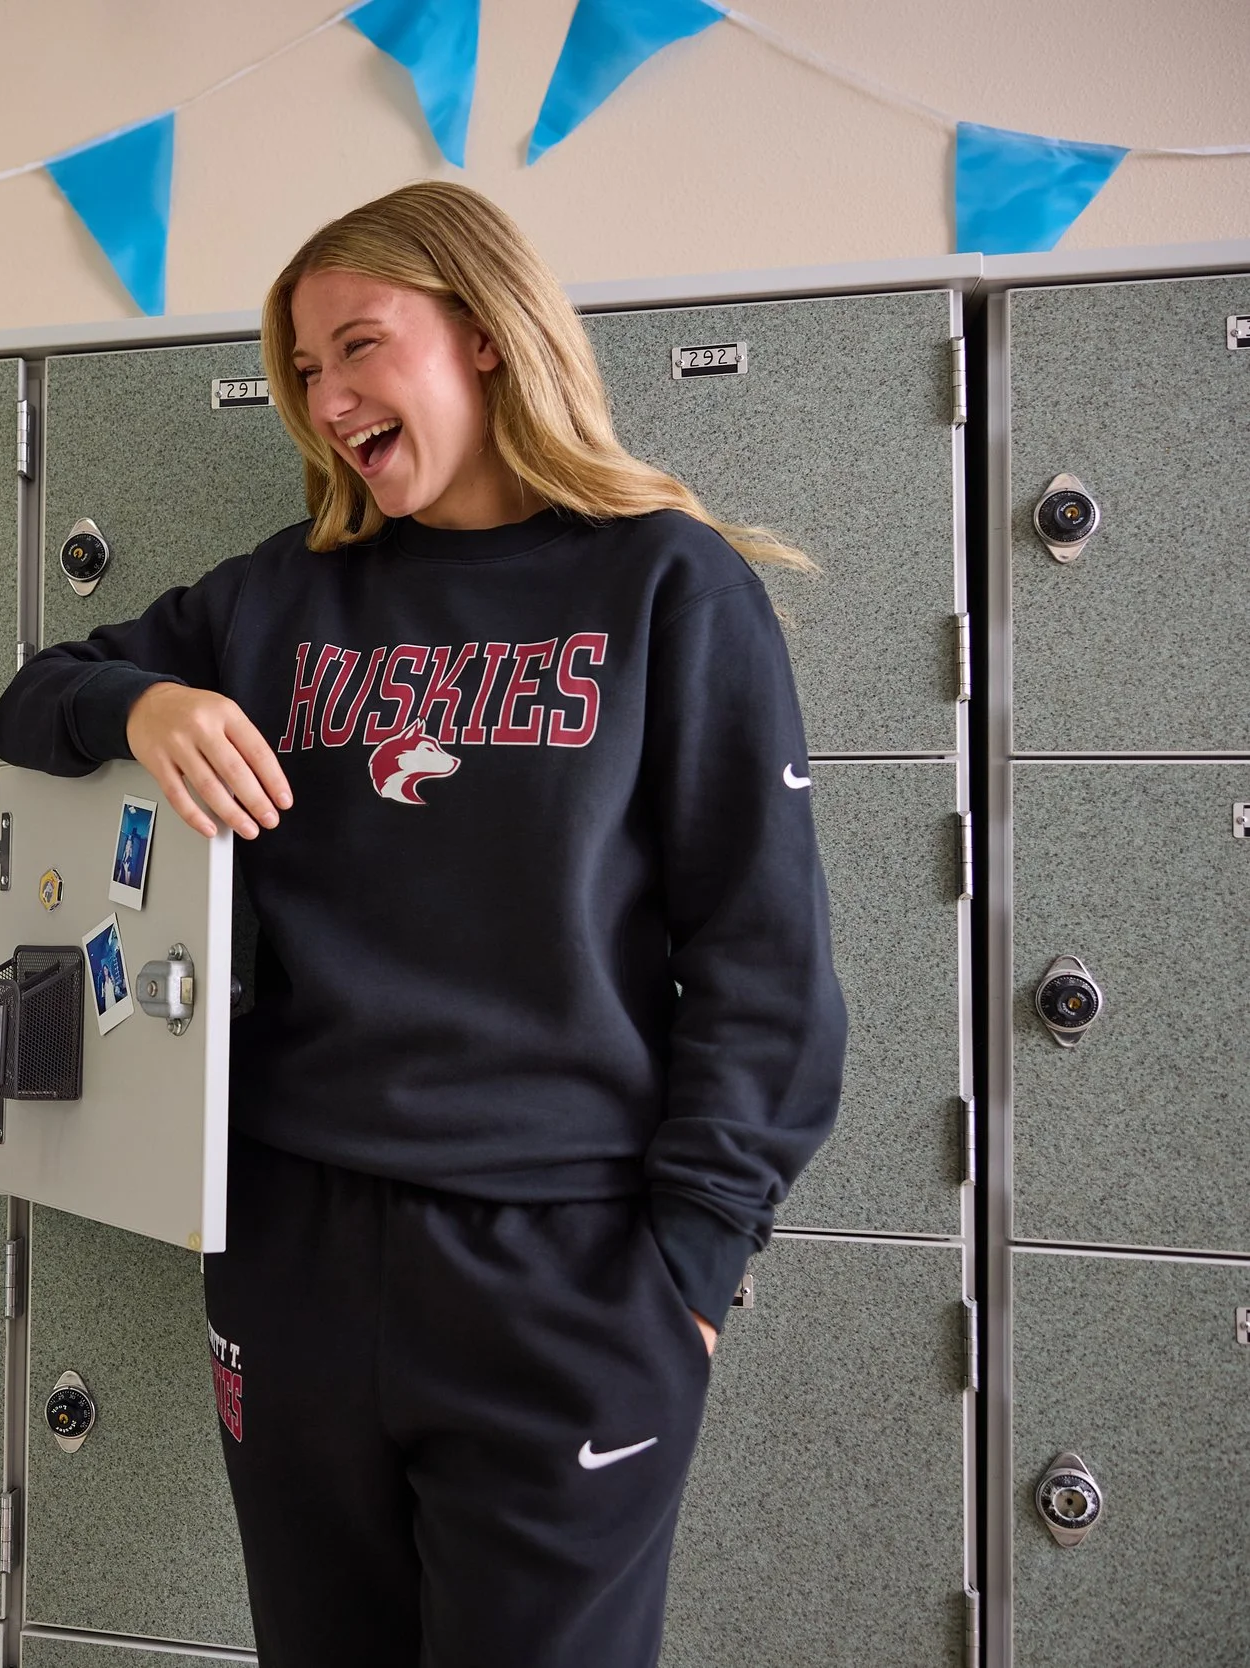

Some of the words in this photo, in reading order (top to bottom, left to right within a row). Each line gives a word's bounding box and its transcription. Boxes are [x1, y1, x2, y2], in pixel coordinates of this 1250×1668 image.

[689, 348, 728, 367] 292
[227, 381, 258, 398] 291
[277, 631, 609, 753] HUSKIES
[229, 1342, 242, 1370] T.
